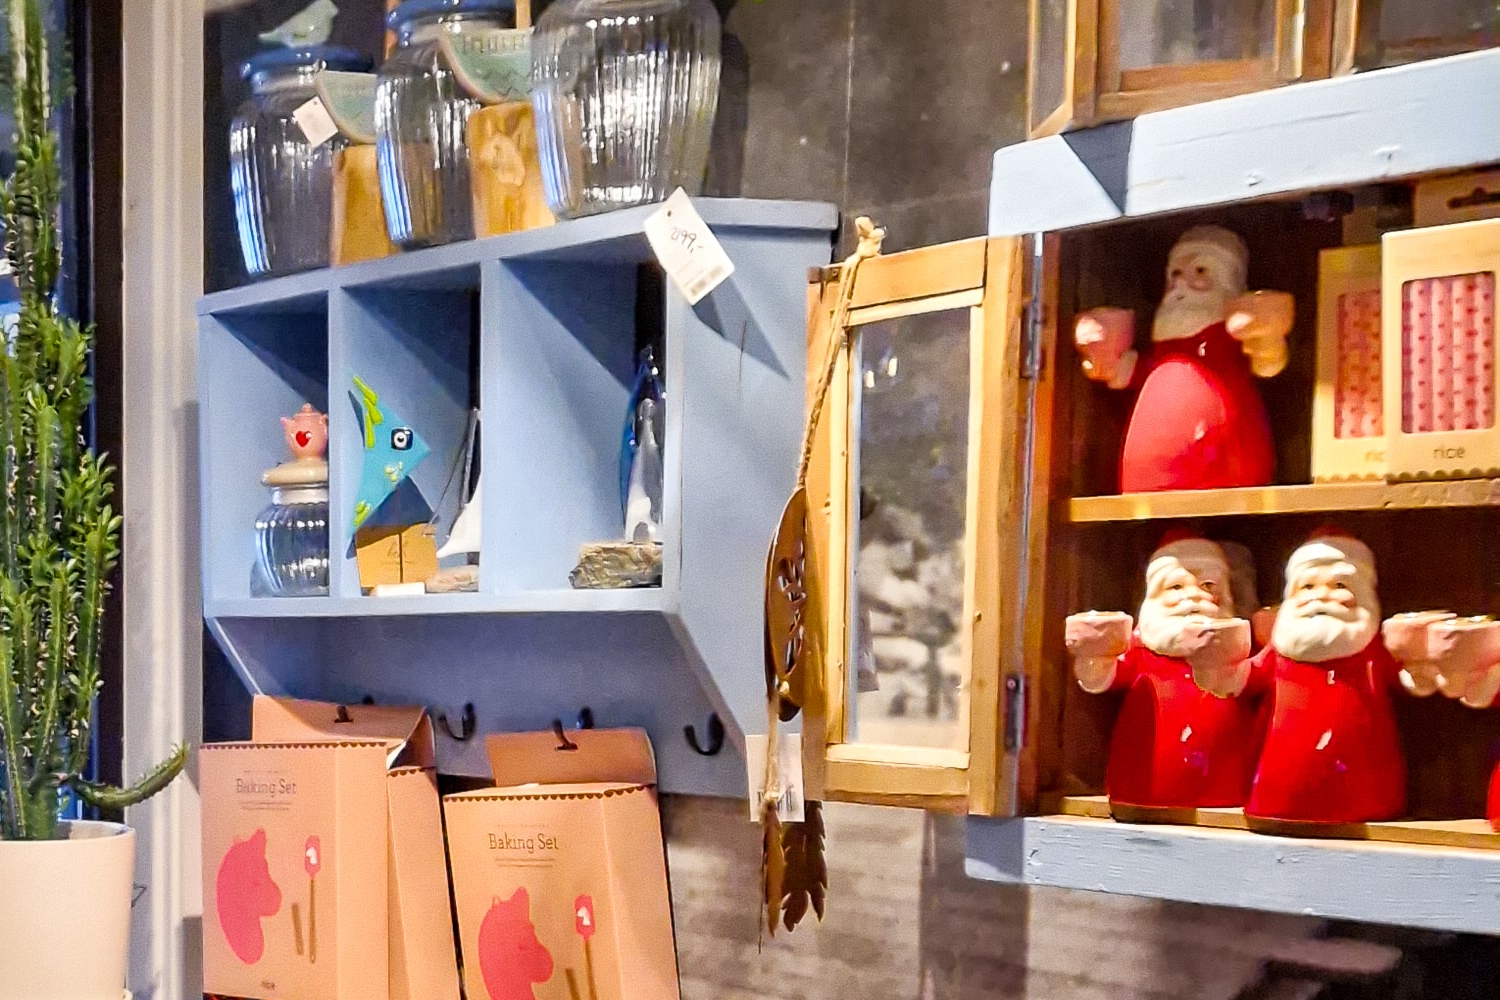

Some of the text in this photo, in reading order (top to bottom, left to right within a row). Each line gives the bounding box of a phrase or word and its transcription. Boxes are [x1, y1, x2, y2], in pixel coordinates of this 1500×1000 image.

[279, 778, 297, 794] Set
[488, 832, 559, 854] Baking Set
